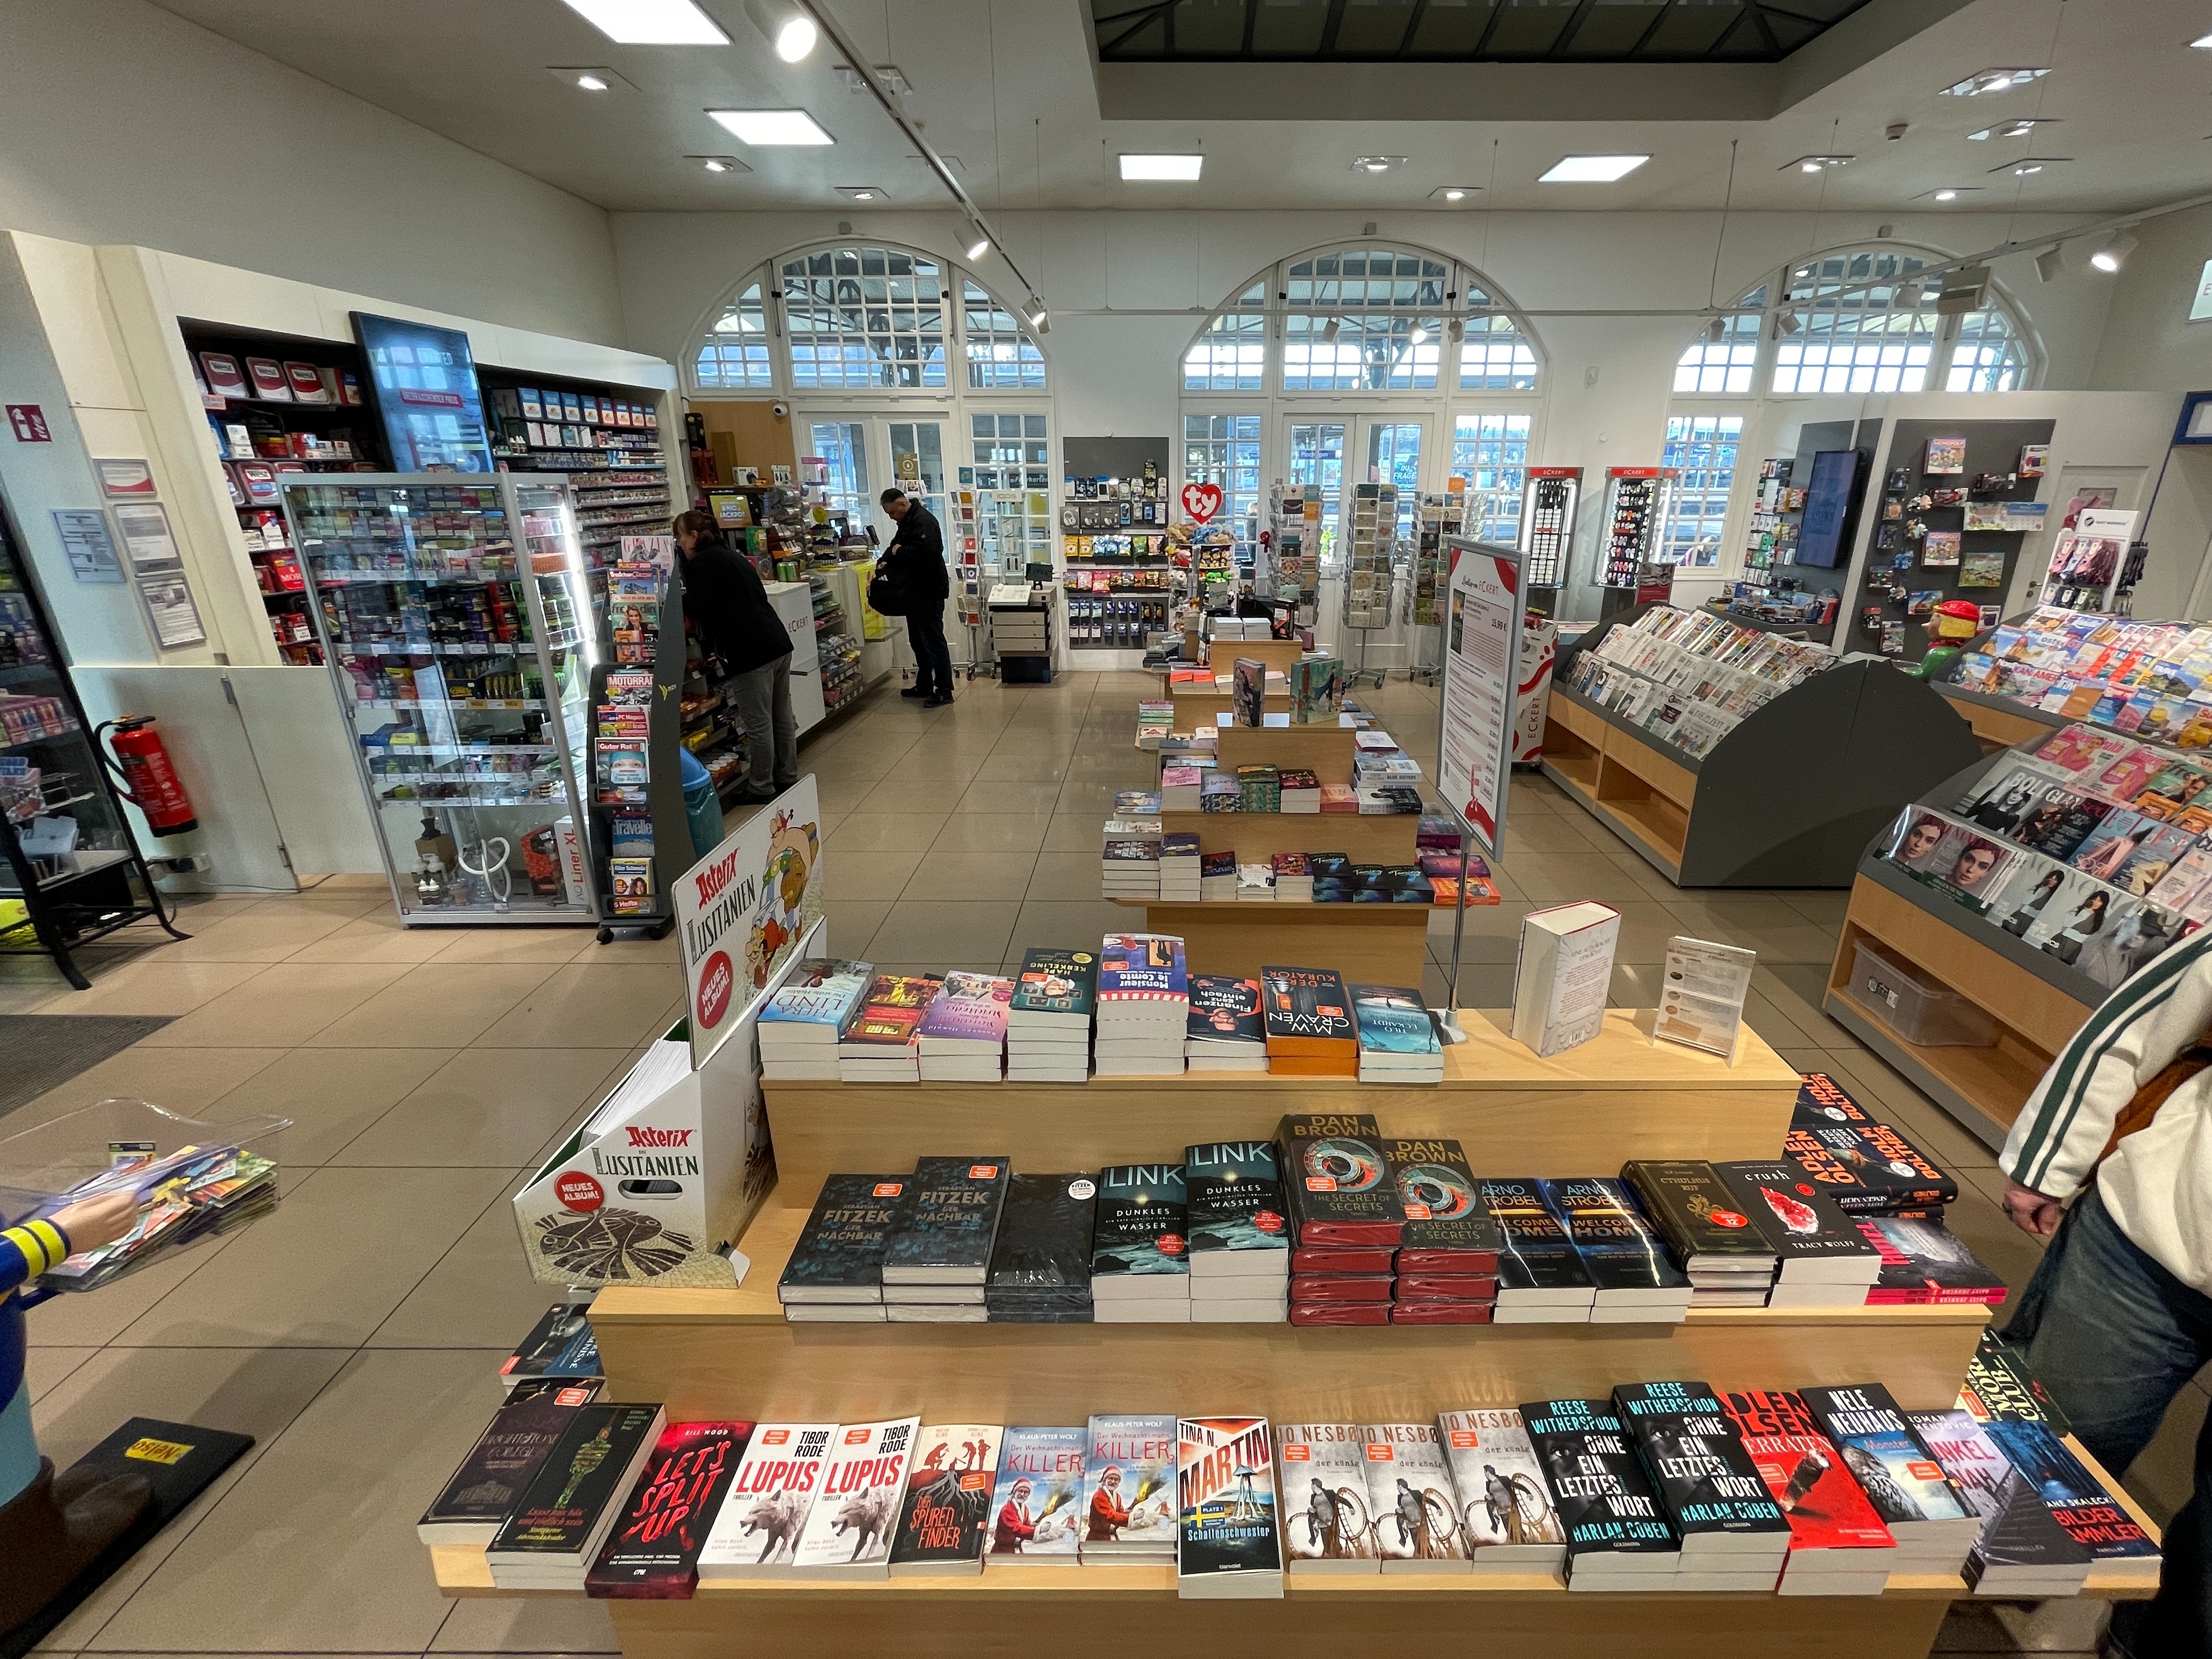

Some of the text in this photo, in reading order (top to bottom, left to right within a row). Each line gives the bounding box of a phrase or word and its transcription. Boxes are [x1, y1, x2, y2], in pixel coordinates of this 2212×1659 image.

[1184, 486, 1218, 520] ty
[1479, 580, 1498, 596] ECKERT
[612, 602, 656, 614] fredin
[788, 616, 809, 633] ECKERT
[1528, 697, 1541, 739] ECKERT
[615, 818, 653, 835] Travelle
[564, 828, 584, 883] Liner XL
[696, 846, 741, 911] Asterix
[686, 874, 756, 967] LUSITANIEN
[1029, 962, 1087, 972] KERKELING
[1043, 967, 1070, 976] HAPE
[701, 962, 725, 1006] NEUES
[1120, 973, 1169, 981] le Comte
[1120, 980, 1169, 989] Monsieur
[1268, 970, 1336, 982] KURATOR
[1289, 978, 1318, 988] DER
[704, 970, 730, 1020] ALBUM!
[775, 995, 846, 1010] LIND
[1201, 991, 1246, 1001] einfach
[781, 1006, 828, 1018] HERA
[1194, 1000, 1252, 1013] Finanzen
[1268, 1012, 1350, 1028] CRAVEN
[1289, 1021, 1332, 1035] M.W.
[1372, 1019, 1418, 1031] ECKARDT
[1810, 1073, 1866, 1120] BOLTHER
[1311, 1116, 1359, 1127] DAN
[626, 1127, 694, 1147] Asterix
[1294, 1125, 1378, 1137] BROWN
[1397, 1141, 1445, 1152] DAN
[1856, 1127, 1907, 1164] HOLM
[1873, 1125, 1943, 1179] BOLTHER
[591, 1148, 700, 1176] LUSITANIEN
[1194, 1142, 1273, 1167] LINK
[1387, 1150, 1465, 1163] BROWN
[1789, 1130, 1855, 1184] OLSEN
[1109, 1165, 1185, 1187] LINK
[1745, 1170, 1790, 1181] crush
[561, 1182, 594, 1193] NEUES
[564, 1190, 600, 1201] ALBUM!
[1206, 1184, 1262, 1194] DUNKLES
[1482, 1185, 1525, 1196] ARNO
[1567, 1185, 1611, 1196] ARNO
[919, 1191, 989, 1204] FITZEK
[1211, 1198, 1259, 1208] WASSER
[1332, 1193, 1377, 1202] SECRET
[1483, 1195, 1542, 1207] TROBEL
[1562, 1195, 1629, 1207] STROBEL
[1117, 1208, 1170, 1217] DUNKLES
[1329, 1202, 1384, 1211] SECRETS
[822, 1209, 893, 1223] FITZEK
[915, 1212, 981, 1222] NACHBAR
[1119, 1222, 1167, 1231] WASSER
[1410, 1222, 1428, 1230] THE
[1428, 1221, 1474, 1230] SECRET
[817, 1232, 882, 1240] NACHBAR
[1426, 1230, 1480, 1240] SECRETS
[1791, 1241, 1823, 1249] TRACY
[1644, 1382, 1688, 1398] REESE
[1549, 1400, 1591, 1416] REESE
[1626, 1397, 1719, 1416] WITHERSPOON
[1827, 1388, 1874, 1412] NELE
[1442, 1412, 1524, 1432] JO NESBØ
[1530, 1416, 1621, 1435] WITHERSPOON
[1683, 1416, 1728, 1437] OHNE
[1739, 1413, 1826, 1437] LSEN
[1826, 1409, 1907, 1435] NEUHAUS
[1908, 1415, 1946, 1424] ROMAN
[1913, 1421, 1972, 1431] MENTOVIC
[800, 1431, 829, 1444] TIBOR
[883, 1424, 911, 1441] TIBOR
[1179, 1422, 1218, 1448] TINA N.
[1278, 1425, 1358, 1444] JO NESBØ
[1360, 1427, 1377, 1444] JO
[1384, 1426, 1439, 1444] NESBØ
[794, 1445, 825, 1457] RODE
[879, 1438, 908, 1455] RODE
[1094, 1441, 1175, 1465] KILLER 3
[1485, 1445, 1530, 1454] der könig
[1584, 1435, 1626, 1455] OHNE
[1677, 1436, 1710, 1456] EIN
[1743, 1437, 1835, 1456] ERRATEN
[1863, 1439, 1910, 1450] Monster
[654, 1440, 732, 1485] LET'S
[1007, 1454, 1082, 1473] KILLER
[1179, 1423, 1270, 1511] MARTIN
[1315, 1459, 1360, 1468] der könig
[1399, 1459, 1444, 1468] der könig
[1577, 1455, 1607, 1475] EIN
[1658, 1456, 1727, 1479] LETZTES
[735, 1461, 820, 1493] LUPUS
[824, 1455, 903, 1494] LUPUS
[632, 1467, 725, 1519] SPLIT
[1555, 1476, 1621, 1499] LETZTES
[1710, 1476, 1764, 1499] WORT
[1605, 1496, 1657, 1518] WORT
[1680, 1501, 1781, 1523] HARLAN COBEN
[641, 1505, 689, 1543] UP
[909, 1506, 955, 1529] SPUREN
[2052, 1507, 2125, 1526] BILDER
[917, 1527, 961, 1550] FINDER
[1187, 1526, 1270, 1541] Schattenschwester
[1571, 1521, 1671, 1543] HARLAN COBEN
[2068, 1523, 2149, 1544] MMLER
